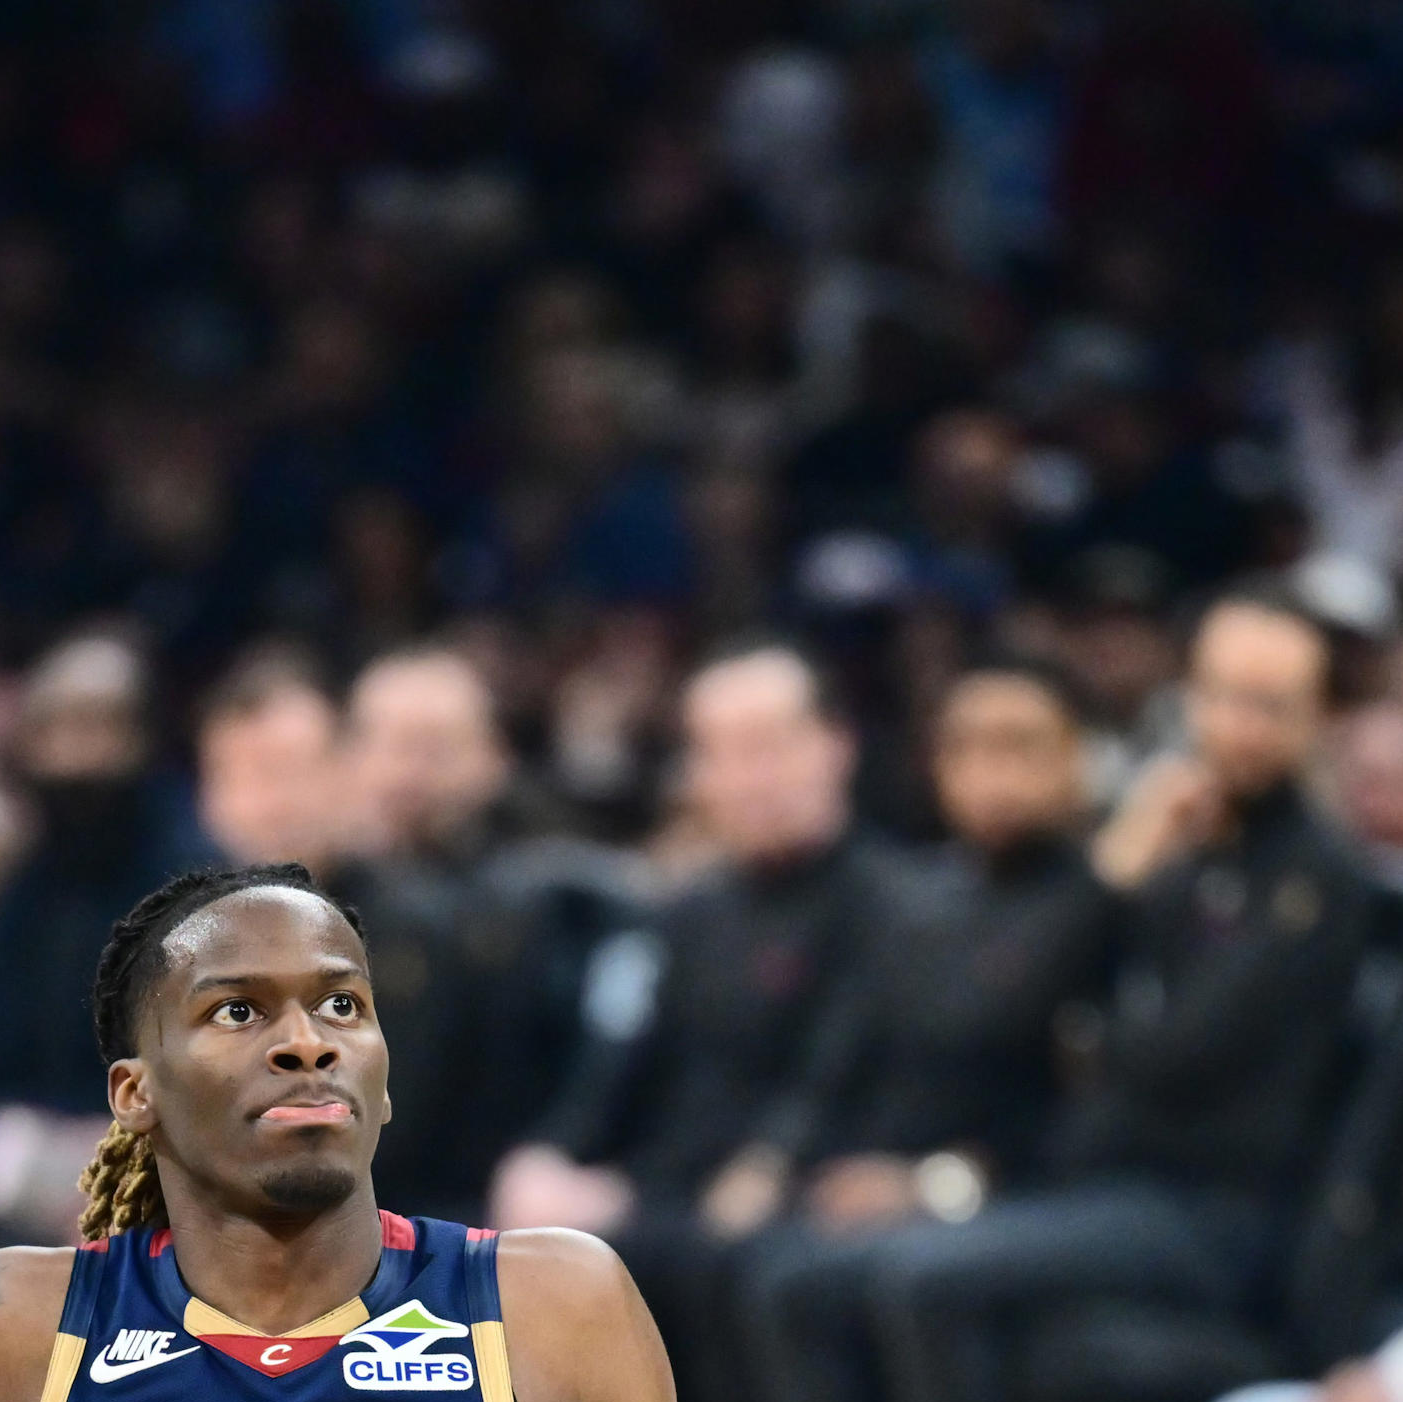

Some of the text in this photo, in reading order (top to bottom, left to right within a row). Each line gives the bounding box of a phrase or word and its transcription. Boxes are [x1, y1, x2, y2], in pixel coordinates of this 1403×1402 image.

[106, 1329, 176, 1361] NIKE
[260, 1344, 292, 1366] C
[349, 1360, 469, 1382] CLIFFS
